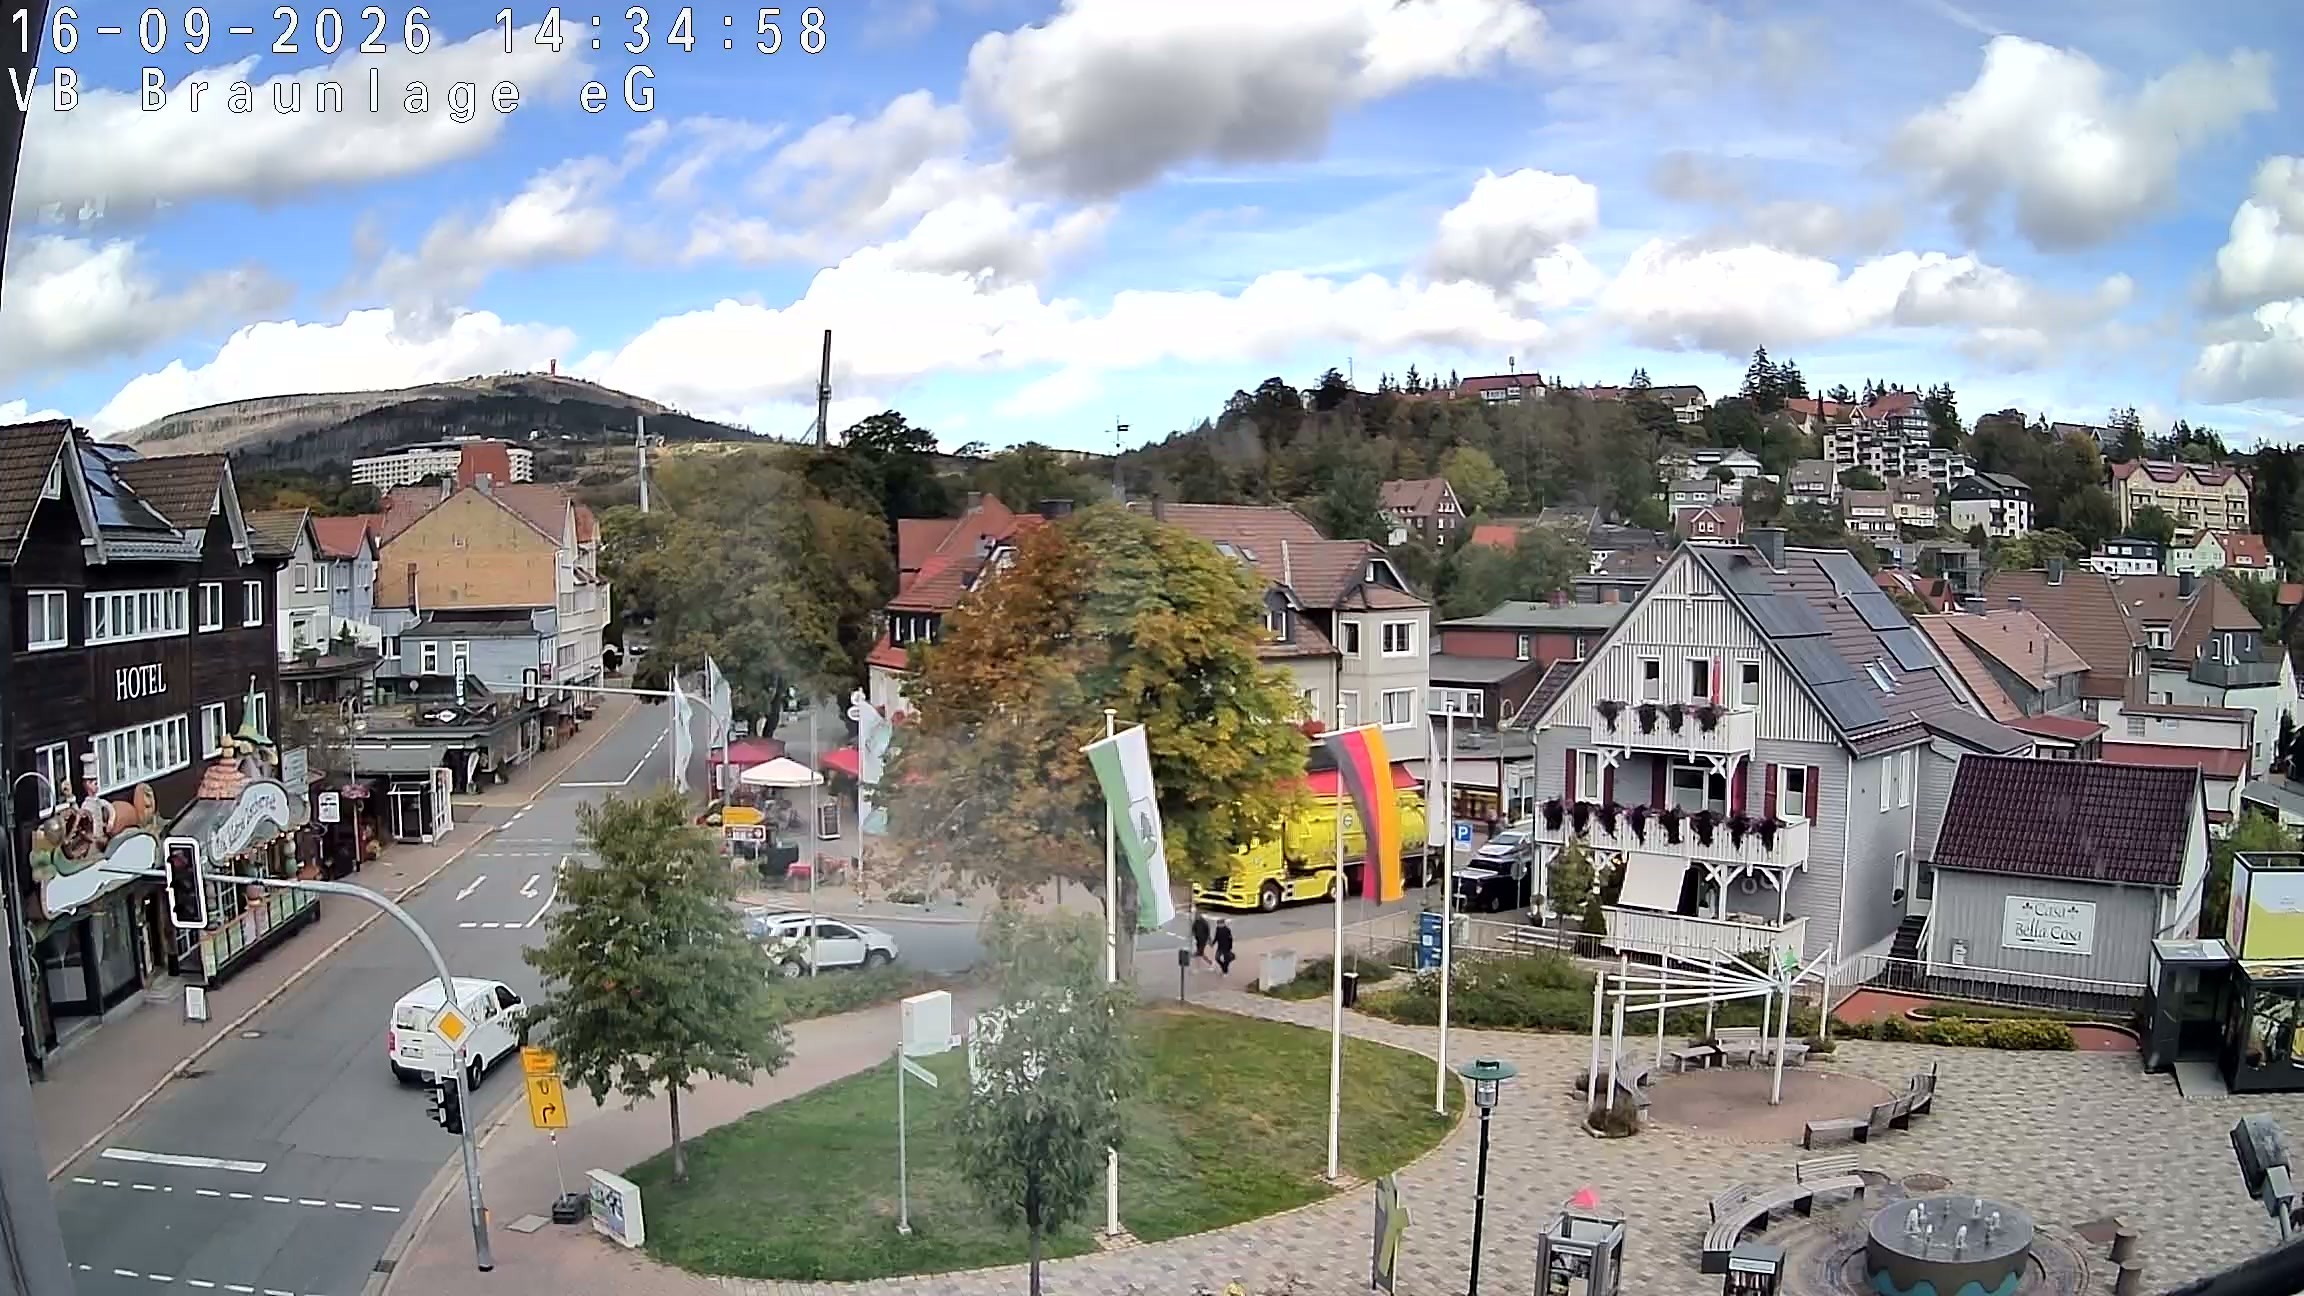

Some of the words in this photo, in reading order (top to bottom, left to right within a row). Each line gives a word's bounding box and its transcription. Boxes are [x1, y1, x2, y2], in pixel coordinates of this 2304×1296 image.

[116, 663, 167, 701] HOTEL
[1458, 825, 1468, 840] P
[2015, 917, 2047, 938] Bella
[2050, 926, 2082, 941] Casa
